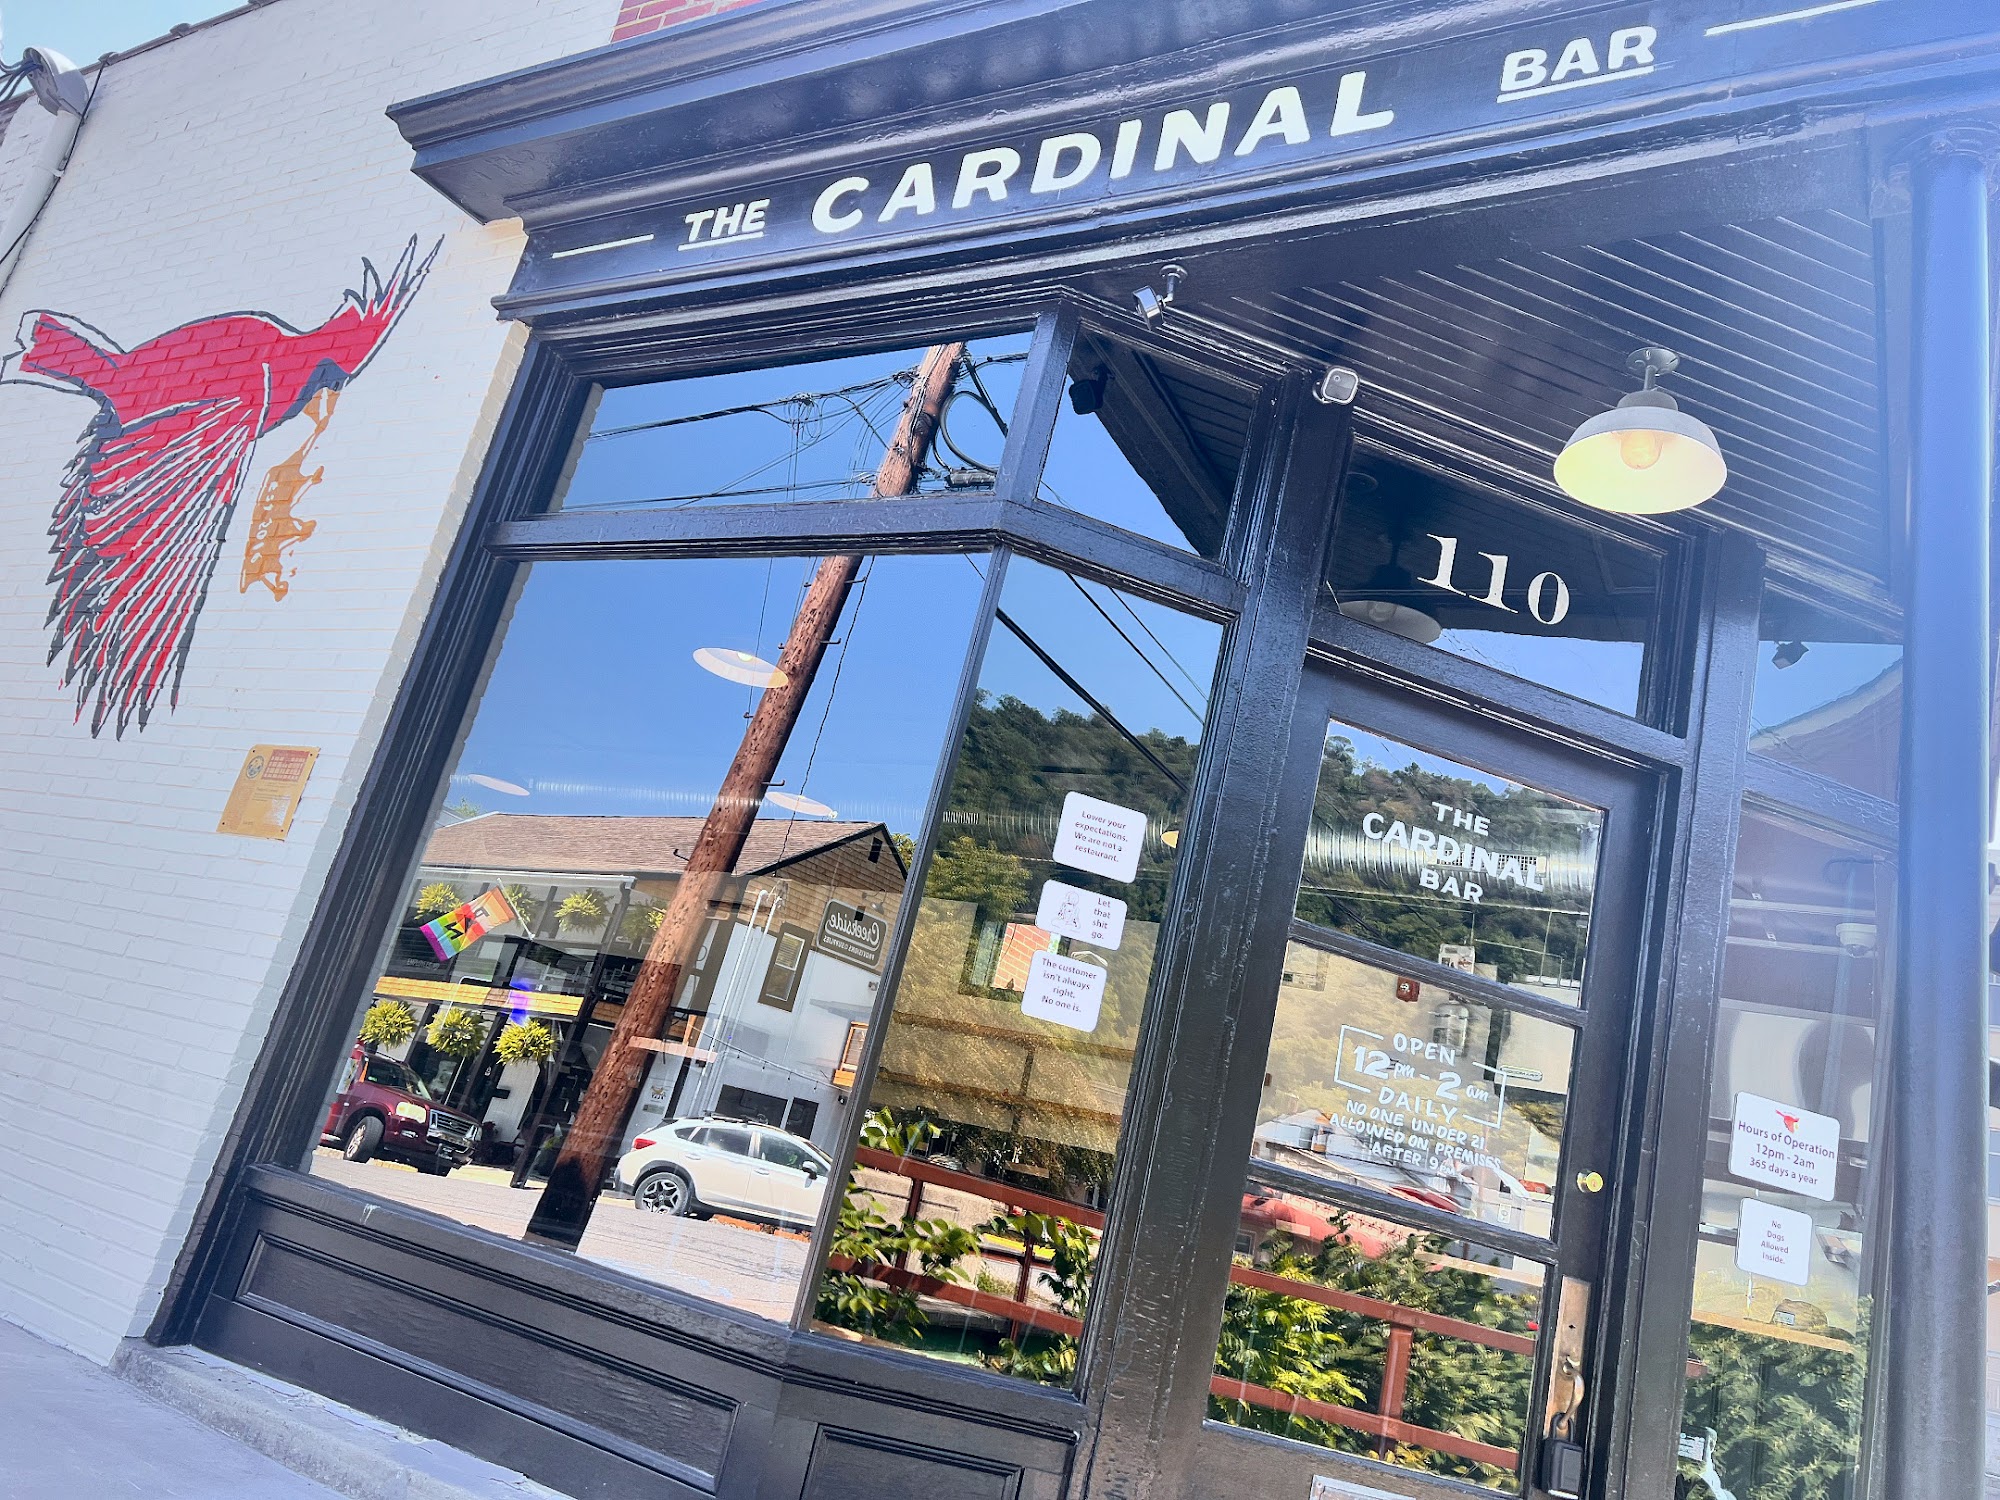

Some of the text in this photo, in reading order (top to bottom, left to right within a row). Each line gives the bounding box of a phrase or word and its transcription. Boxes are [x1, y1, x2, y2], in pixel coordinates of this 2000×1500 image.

[685, 26, 1657, 243] THE CARDINAL BAR
[1417, 533, 1569, 625] 110
[1081, 810, 1127, 829] Lower your
[1432, 801, 1491, 836] THE
[1074, 821, 1128, 842] expectations.
[1074, 831, 1087, 841] We
[1088, 837, 1101, 845] are
[1102, 841, 1116, 850] not
[1075, 844, 1119, 862] restaurant.
[1362, 812, 1544, 892] CARDINAL
[1419, 868, 1484, 904] BAR
[1094, 908, 1111, 919] that
[1098, 898, 1111, 908] Let
[1092, 919, 1108, 929] shit
[1091, 931, 1104, 940] go.
[1042, 958, 1097, 979] The customer
[1043, 970, 1090, 990] isn't always
[1053, 986, 1075, 998] right.
[1041, 995, 1082, 1012] No one is.
[1393, 1032, 1456, 1066] OPEN
[1378, 1086, 1458, 1124] DAILY
[1346, 1100, 1485, 1150] NO ONE UNDER 21
[1329, 1113, 1501, 1169] ALLOWED ON PREMISES
[1738, 1121, 1835, 1159] Hours of Operation
[1371, 1142, 1422, 1167] AFTER
[1756, 1143, 1785, 1161] 12pm
[1793, 1157, 1815, 1170] 2am
[1750, 1157, 1818, 1185] 365 days a year
[1771, 1220, 1781, 1229] No
[1767, 1230, 1785, 1242] Dogs
[1760, 1240, 1789, 1254] Allowed
[1762, 1252, 1785, 1265] Inside.
